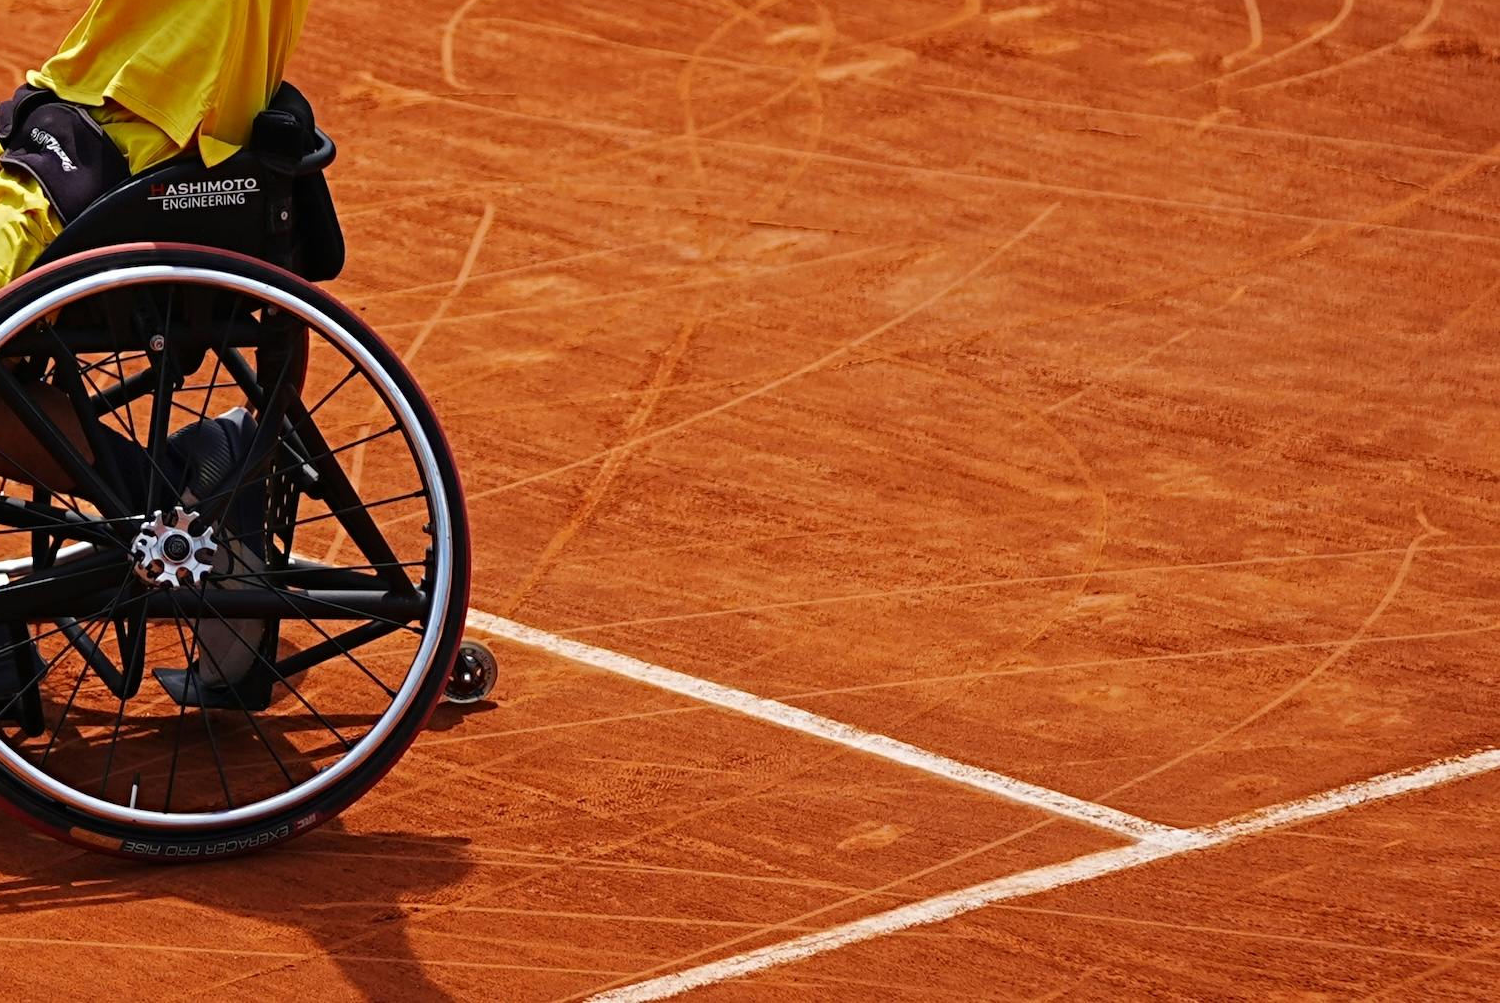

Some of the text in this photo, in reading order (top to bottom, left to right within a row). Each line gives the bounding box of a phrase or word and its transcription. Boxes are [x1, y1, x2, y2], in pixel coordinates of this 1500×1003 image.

[150, 178, 257, 196] HASHIMOTO
[163, 193, 245, 210] ENGINEERING
[123, 841, 161, 855] RISE
[205, 825, 290, 855] EXERACER
[164, 846, 200, 856] PRO
